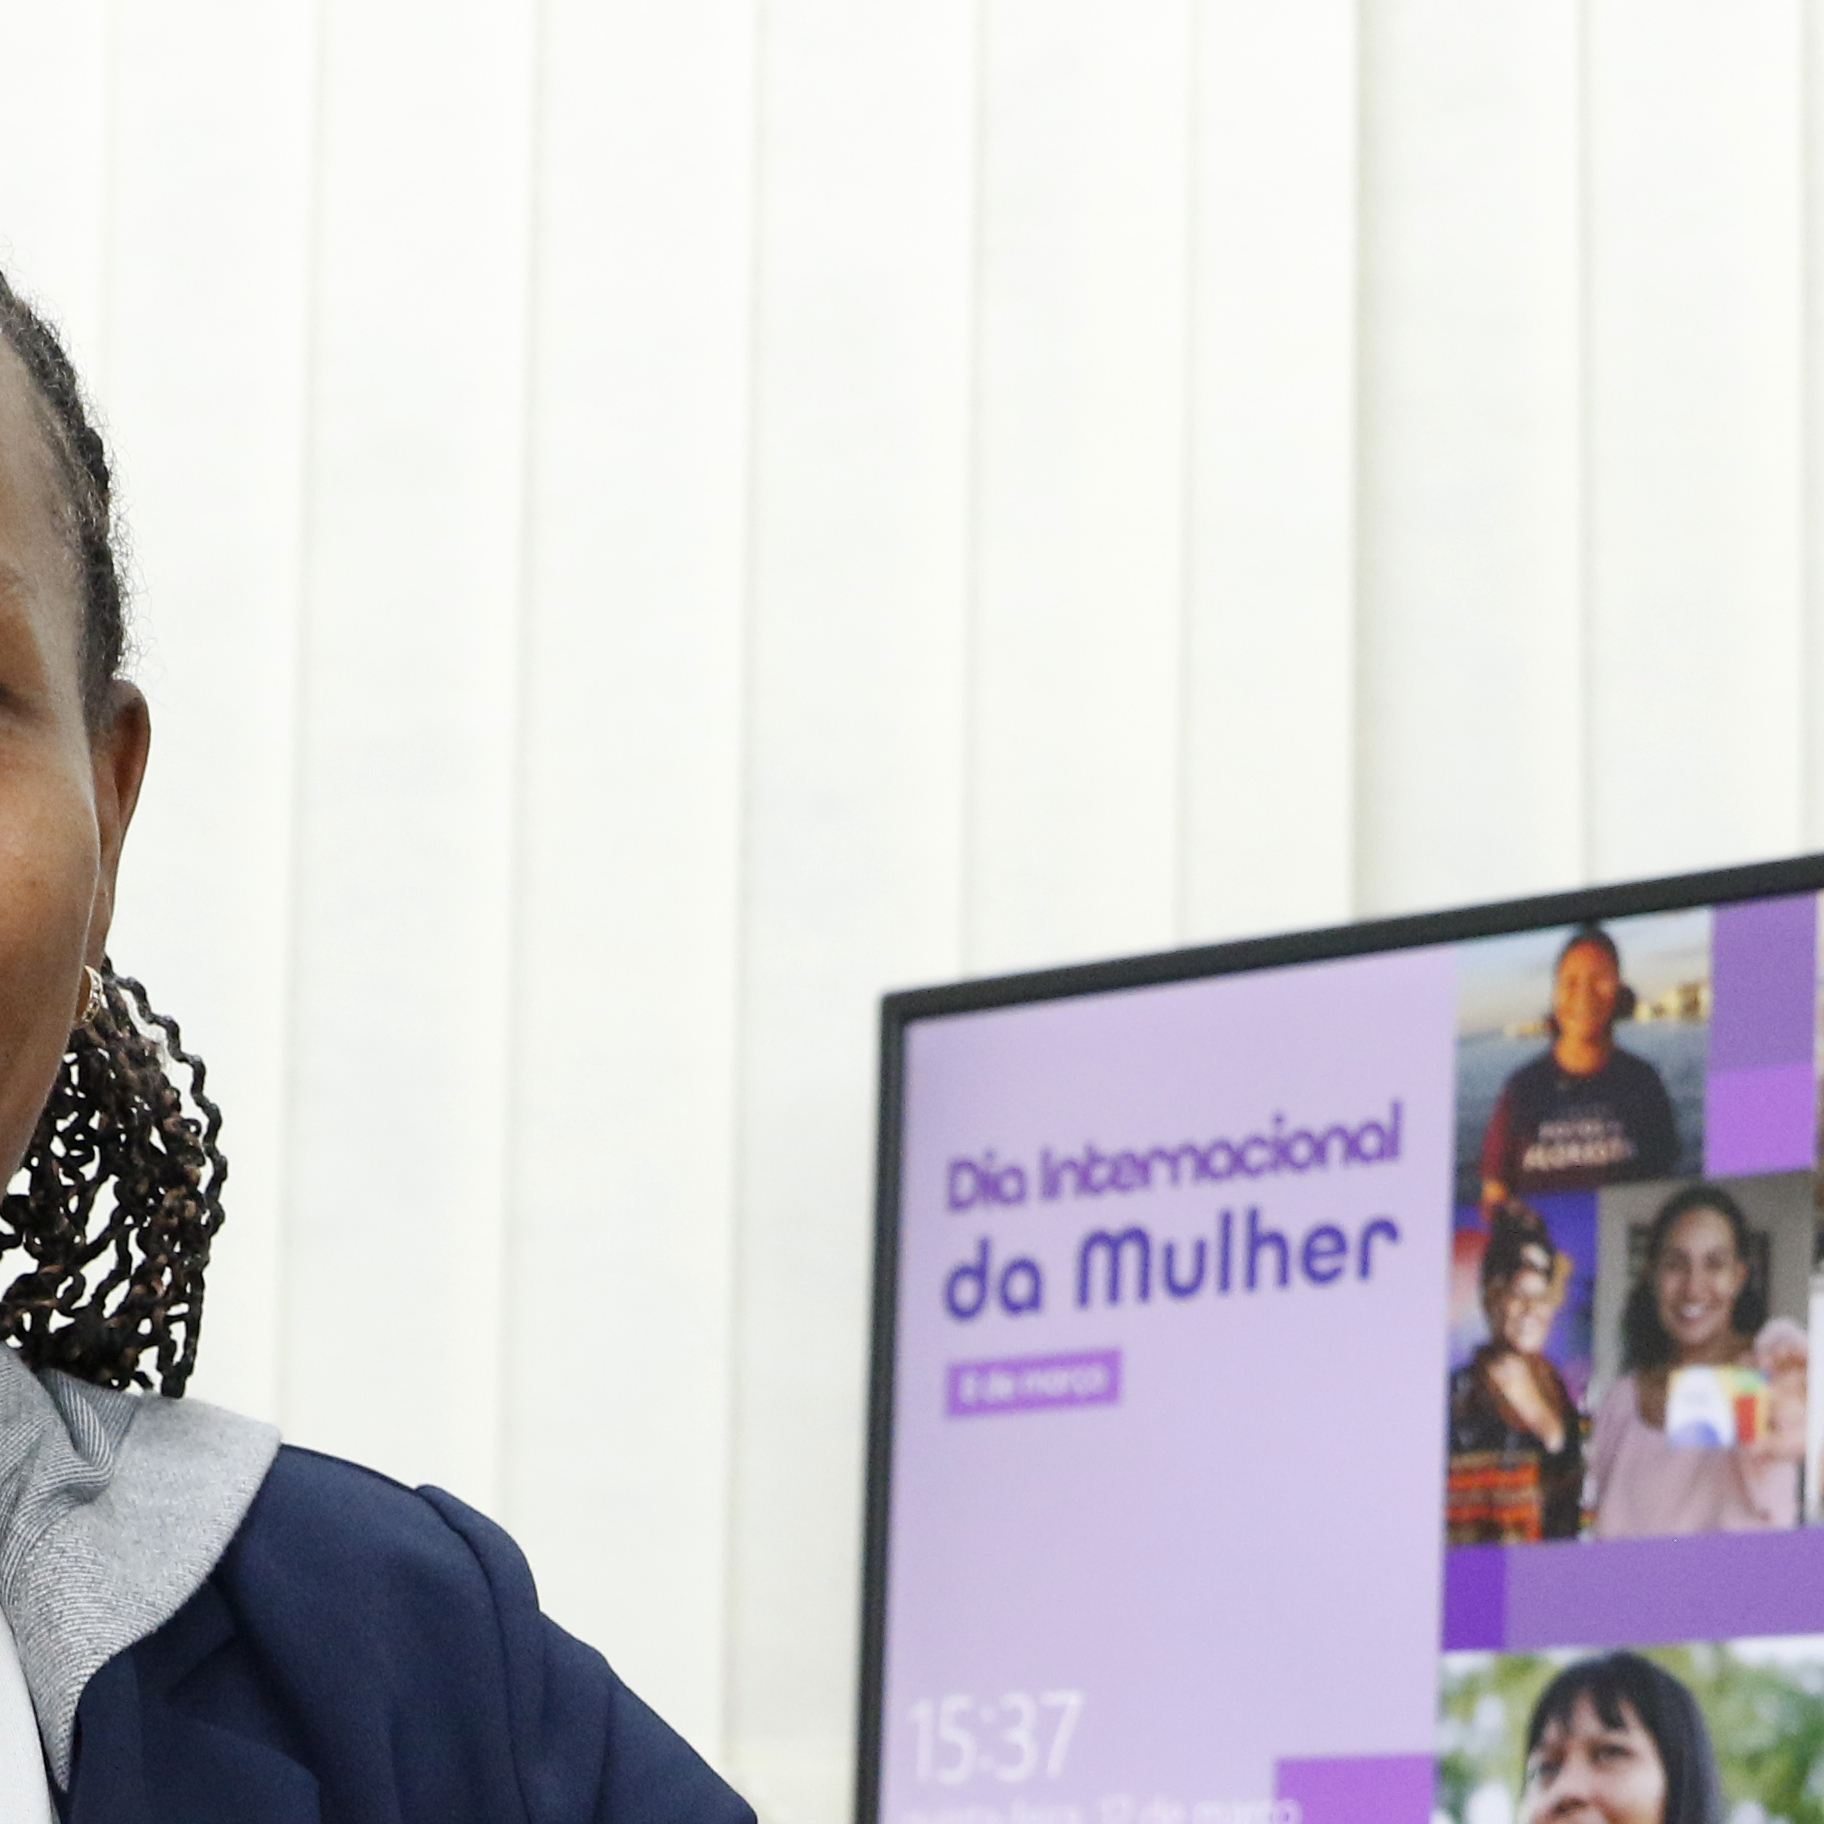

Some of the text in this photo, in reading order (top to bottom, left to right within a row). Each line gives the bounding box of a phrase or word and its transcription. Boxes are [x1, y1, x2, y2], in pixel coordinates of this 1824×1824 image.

[948, 1098, 1401, 1212] Dia Internacional
[945, 1206, 1399, 1322] da Mulher
[907, 1689, 1085, 1787] 15:37
